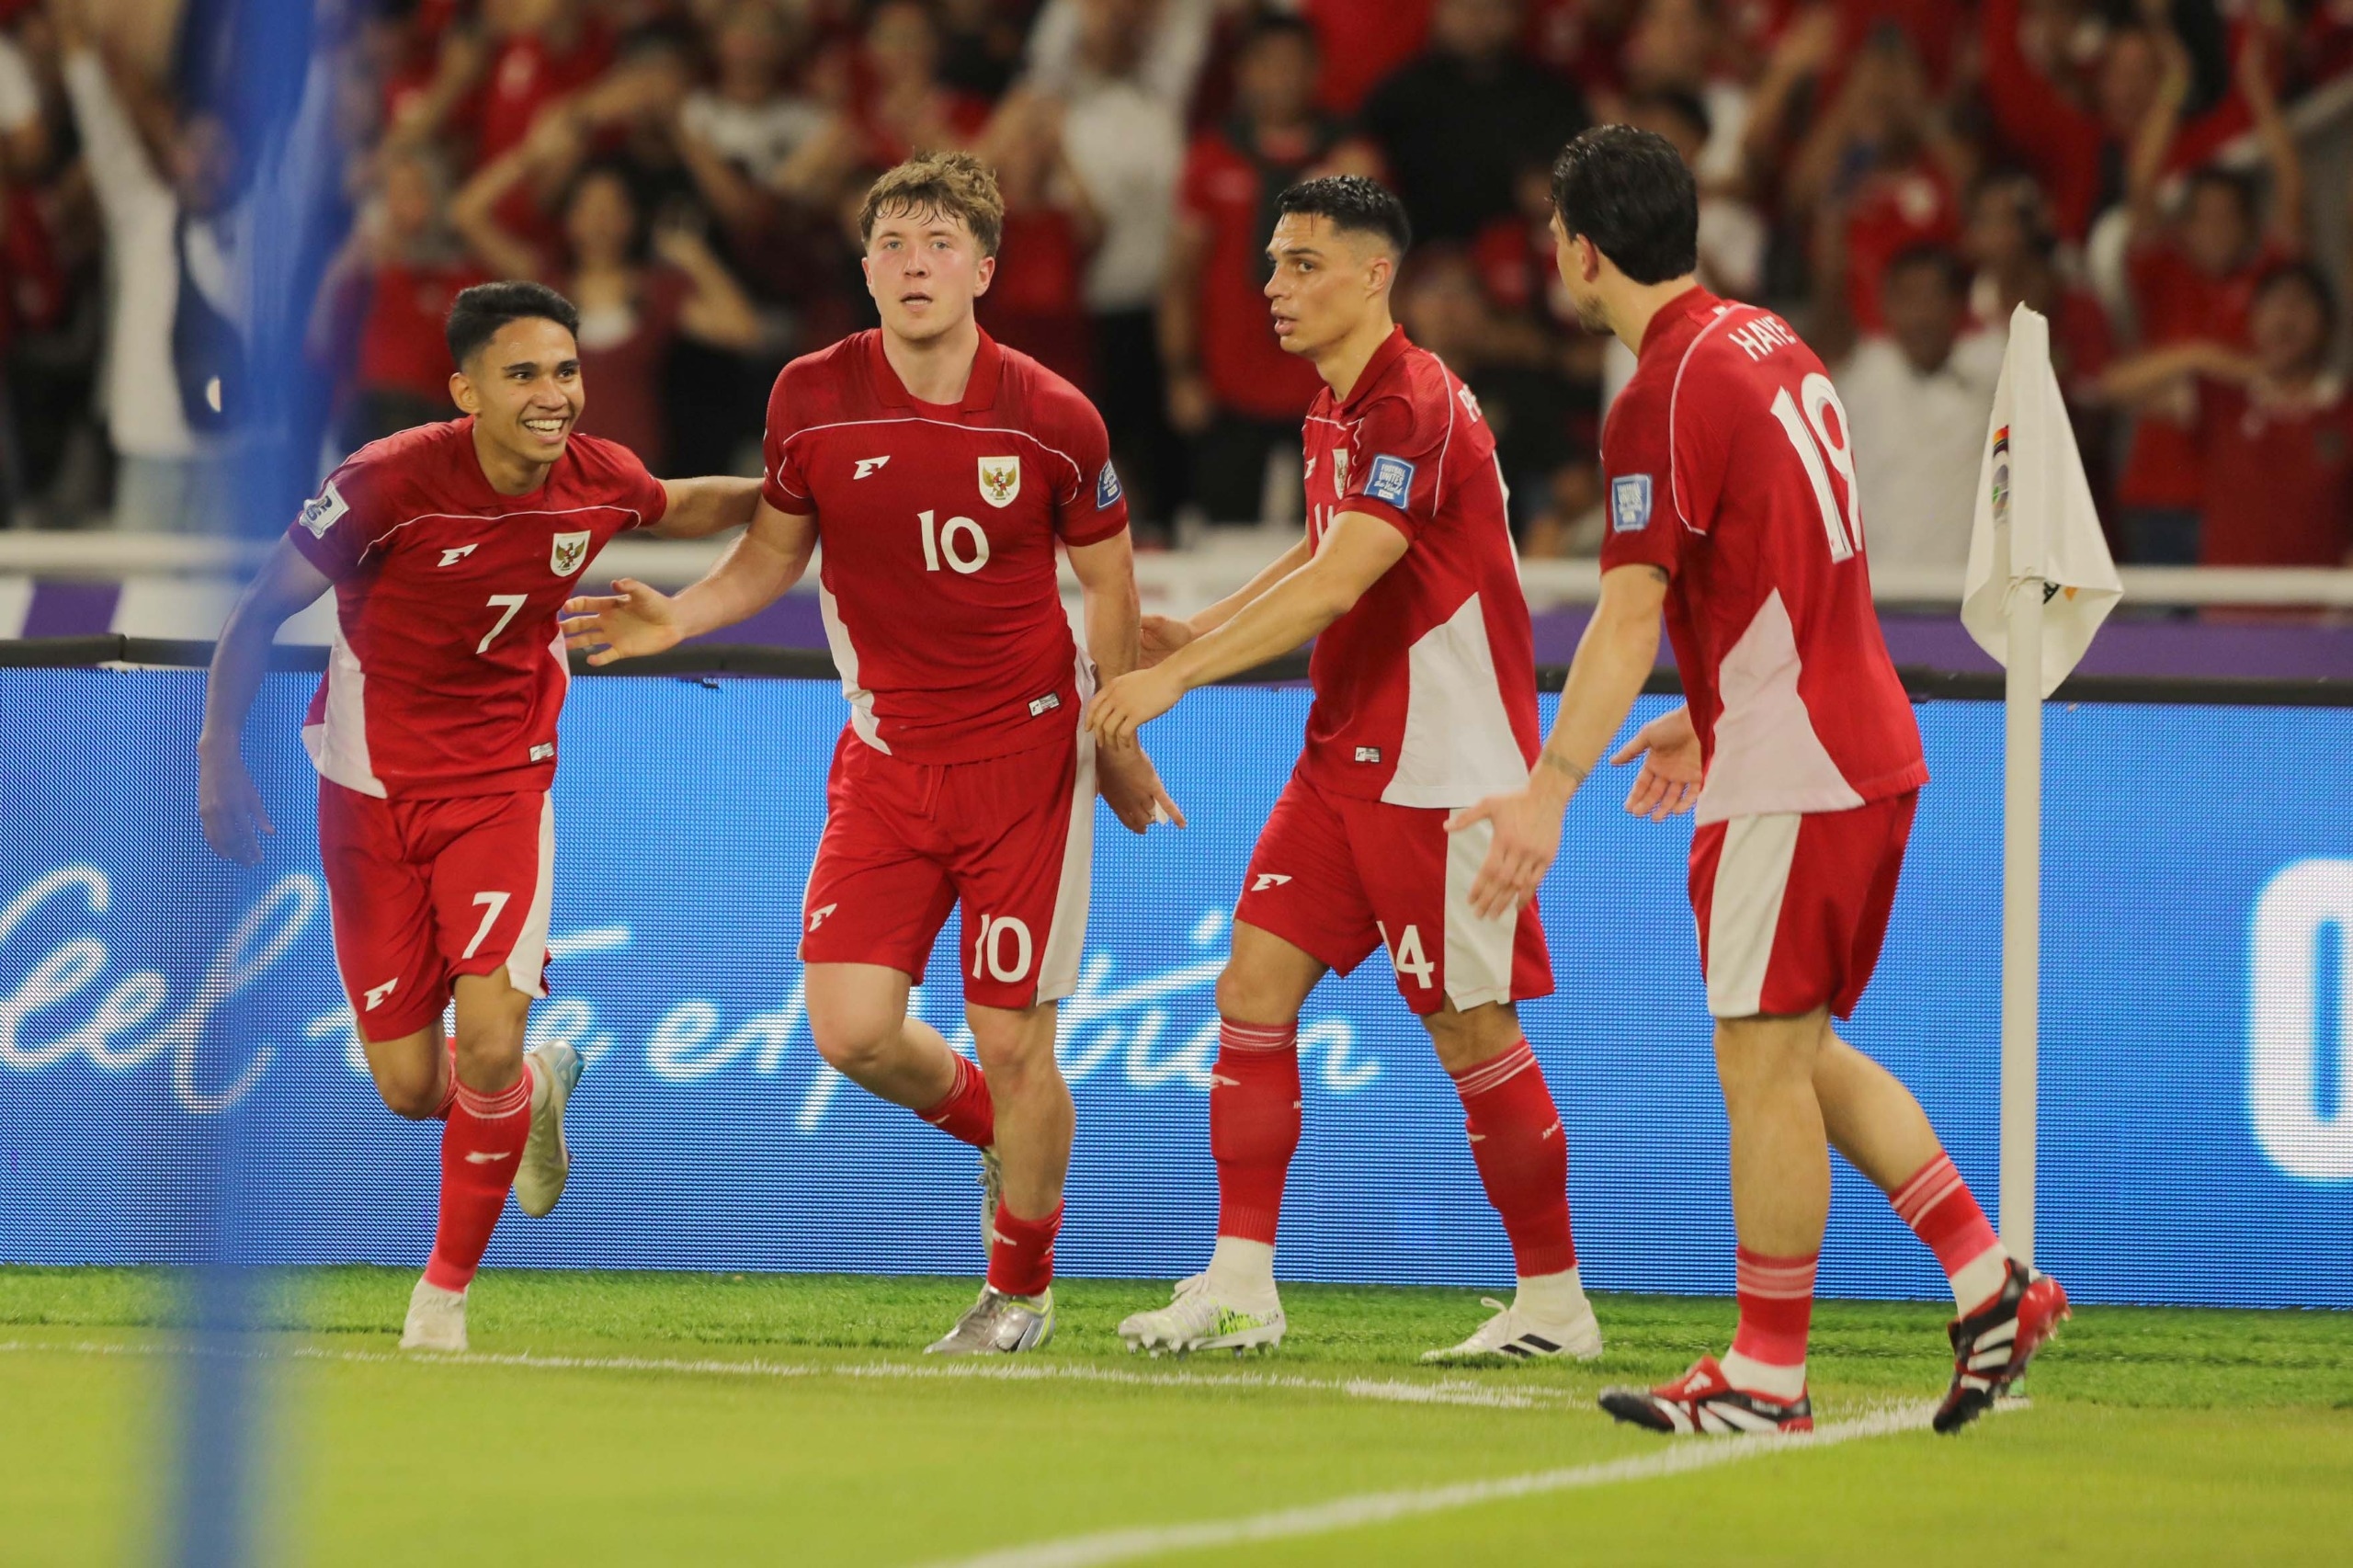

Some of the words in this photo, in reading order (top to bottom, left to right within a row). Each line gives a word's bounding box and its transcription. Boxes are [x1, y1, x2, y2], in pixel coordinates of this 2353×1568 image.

[1769, 372, 1863, 563] 19
[917, 509, 990, 574] 10
[476, 594, 529, 654] 7
[461, 892, 511, 959] 7
[972, 914, 1032, 983] 10
